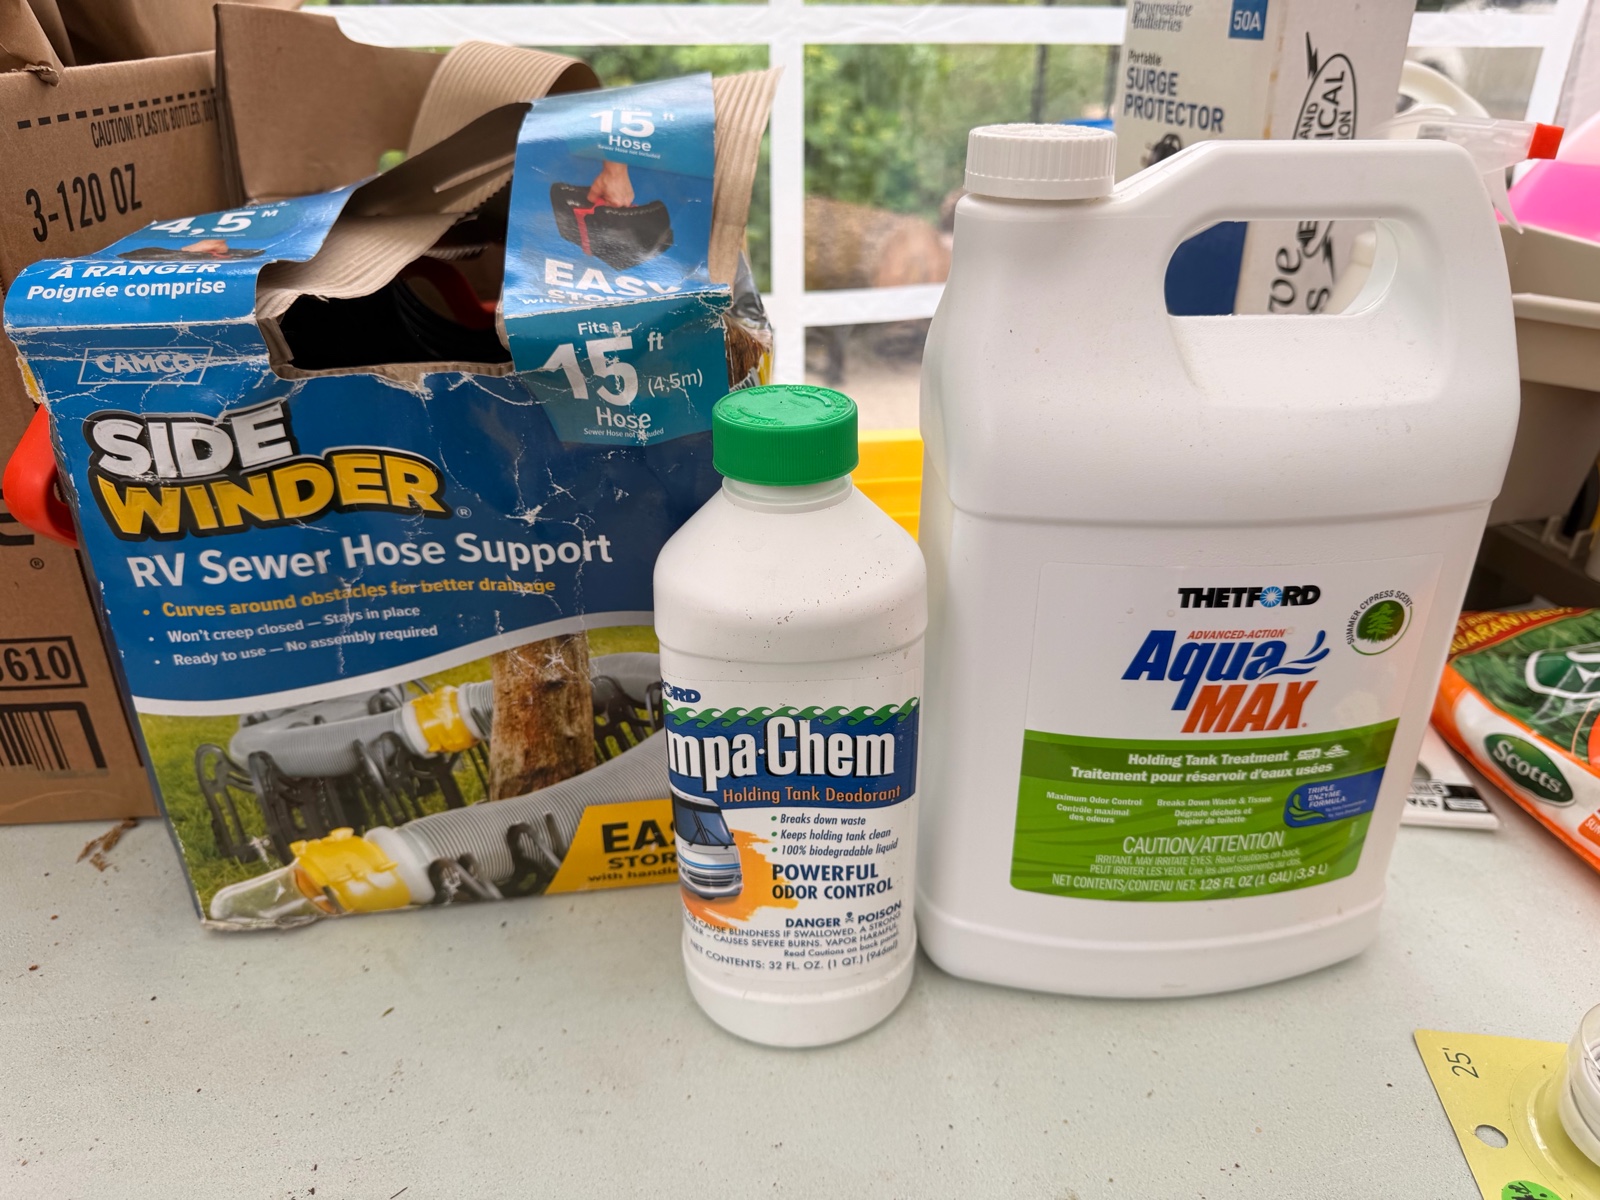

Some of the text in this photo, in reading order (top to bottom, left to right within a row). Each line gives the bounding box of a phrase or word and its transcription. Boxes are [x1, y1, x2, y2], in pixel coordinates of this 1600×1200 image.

[1233, 10, 1262, 32] 50A
[1127, 48, 1162, 66] Portable
[1126, 67, 1179, 97] SURGE
[589, 110, 655, 138] 15
[1124, 94, 1225, 134] PROTECTOR
[90, 114, 136, 148] CAUTION!
[136, 107, 170, 138] PLASTIC
[609, 135, 652, 152] Hose
[26, 163, 142, 243] 3-120 OZ
[150, 209, 279, 236] 4,5 M
[48, 263, 222, 279] À RANGER
[545, 258, 682, 297] EASY
[27, 277, 227, 303] Poignée comprise
[578, 321, 606, 336] Fits
[96, 353, 197, 374] CAMCO
[542, 332, 664, 407] 15 ft
[648, 368, 703, 398] (4,5m)
[596, 406, 652, 429] Hose
[92, 402, 294, 479] SIDE
[583, 428, 604, 436] Sewer
[96, 453, 447, 535] WINDER
[126, 532, 614, 588] RV Sewer Hose Support
[162, 577, 556, 618] Curves around obstacles for better drainage
[1178, 584, 1322, 609] THETFORD
[167, 605, 421, 644] Won't creep closed Stays in place
[1345, 589, 1414, 645] SUMMER CYPRESS SCENT
[1187, 628, 1286, 640] ADVANCED-ACTION
[173, 625, 438, 667] Ready to use No assembly required
[0, 645, 71, 682] 610
[1121, 630, 1288, 711] Aqua
[1180, 680, 1319, 733] MAX
[1128, 751, 1290, 768] Holding Tank Treatment
[1493, 739, 1563, 794] Scotts
[1071, 763, 1334, 784] Traitement pour réservoir d'eaux usées
[723, 785, 901, 804] Holding Tank Deodorant
[1046, 791, 1143, 806] Maximum Odor Control
[1157, 795, 1273, 807] Breaks Down Waste & Tissue
[1308, 784, 1335, 795] TRIPLE
[780, 813, 866, 826] Breaks down waste
[1056, 803, 1130, 817] Contrôle maximal
[1069, 813, 1115, 824] des odeurs
[1174, 806, 1252, 818] Dégrade déchets et
[1177, 815, 1247, 827] papier de toilette
[602, 819, 675, 853] EA
[780, 828, 891, 843] Keeps holding tank clean
[1123, 830, 1285, 855] CAUTION/ATTENTION
[782, 838, 898, 858] 100% biodegradable liquid
[1090, 864, 1112, 875] PEUT
[1113, 865, 1144, 876] IRRITER
[1146, 866, 1163, 876] LES
[1135, 854, 1235, 866] MAY IRRITATE Read
[772, 863, 879, 881] POWERFUL
[1052, 870, 1292, 893] NET CONTENTS/CONTENU 128 FL OZ (1 GAL)
[772, 877, 893, 900] ODOR CONTROL
[698, 910, 902, 938] CAUSE BLINDNESS IF SWALLOWED. A STRONG
[785, 899, 902, 928] DANGER POISON
[714, 922, 898, 948] CAUSES SEVERE BURNS. VAPOR HARMFUL
[706, 950, 765, 969] CONTENTS:
[769, 960, 782, 970] 32
[786, 960, 800, 970] FL.
[803, 960, 824, 970] OZ.
[828, 958, 837, 970] (1
[784, 949, 805, 957] Read
[808, 948, 844, 957] Cautions
[860, 940, 878, 952] back
[1442, 1047, 1480, 1079] 25'
